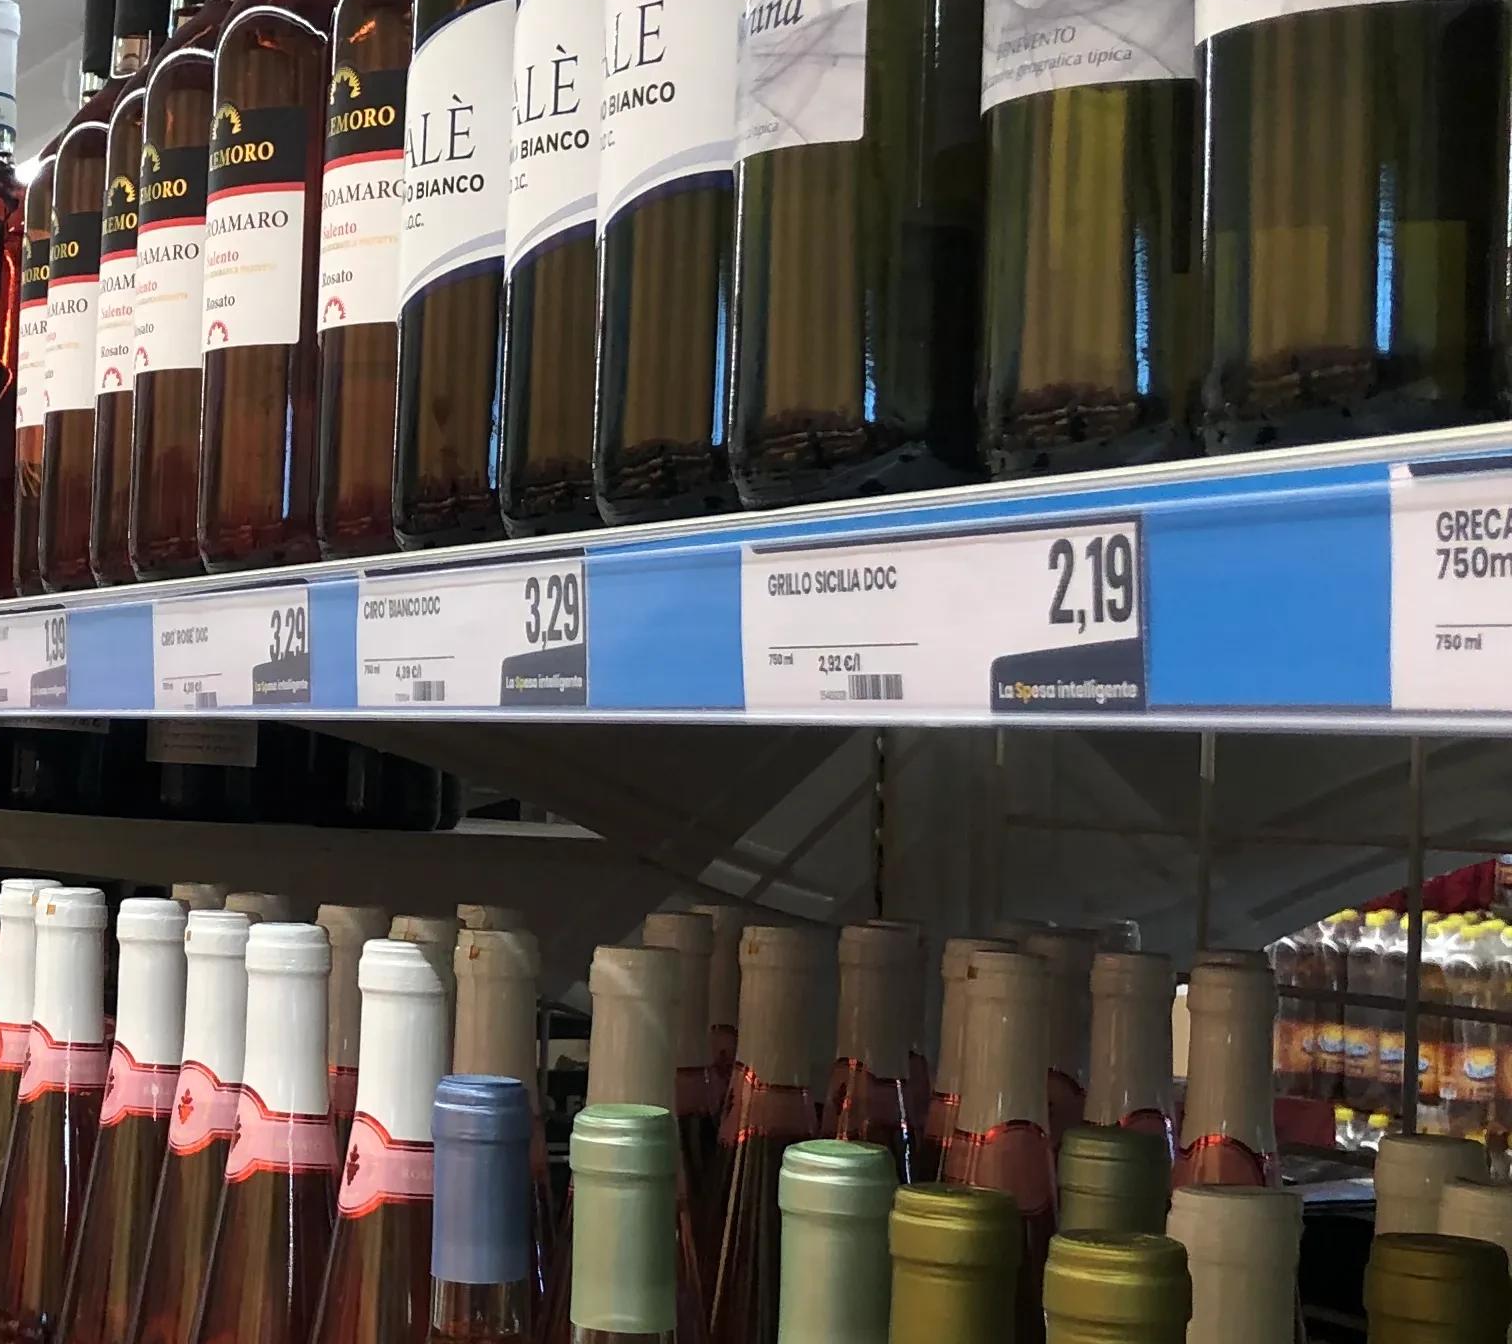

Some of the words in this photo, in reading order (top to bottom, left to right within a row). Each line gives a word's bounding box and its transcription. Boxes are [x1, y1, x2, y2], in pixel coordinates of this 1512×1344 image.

[1088, 47, 1133, 67] tipica
[609, 81, 675, 117] BIANCO
[521, 128, 590, 160] BIANCO
[416, 173, 485, 201] BIANCO
[322, 272, 353, 288] Rosato
[768, 572, 811, 597] GRILLO
[815, 567, 859, 594] SICILIA
[863, 565, 897, 591] DOC
[1048, 533, 1133, 634] 2,19
[364, 597, 388, 619] CIRO'
[389, 597, 420, 619] BIANCO
[422, 595, 441, 616] DOC
[525, 573, 579, 650] 3,29
[44, 617, 65, 665] 1,99
[269, 607, 306, 661] 3,29
[1436, 634, 1462, 651] 750
[1464, 633, 1482, 651] ml
[818, 655, 841, 676] 2,92
[998, 682, 1014, 699] La
[1058, 678, 1137, 704] intelligente
